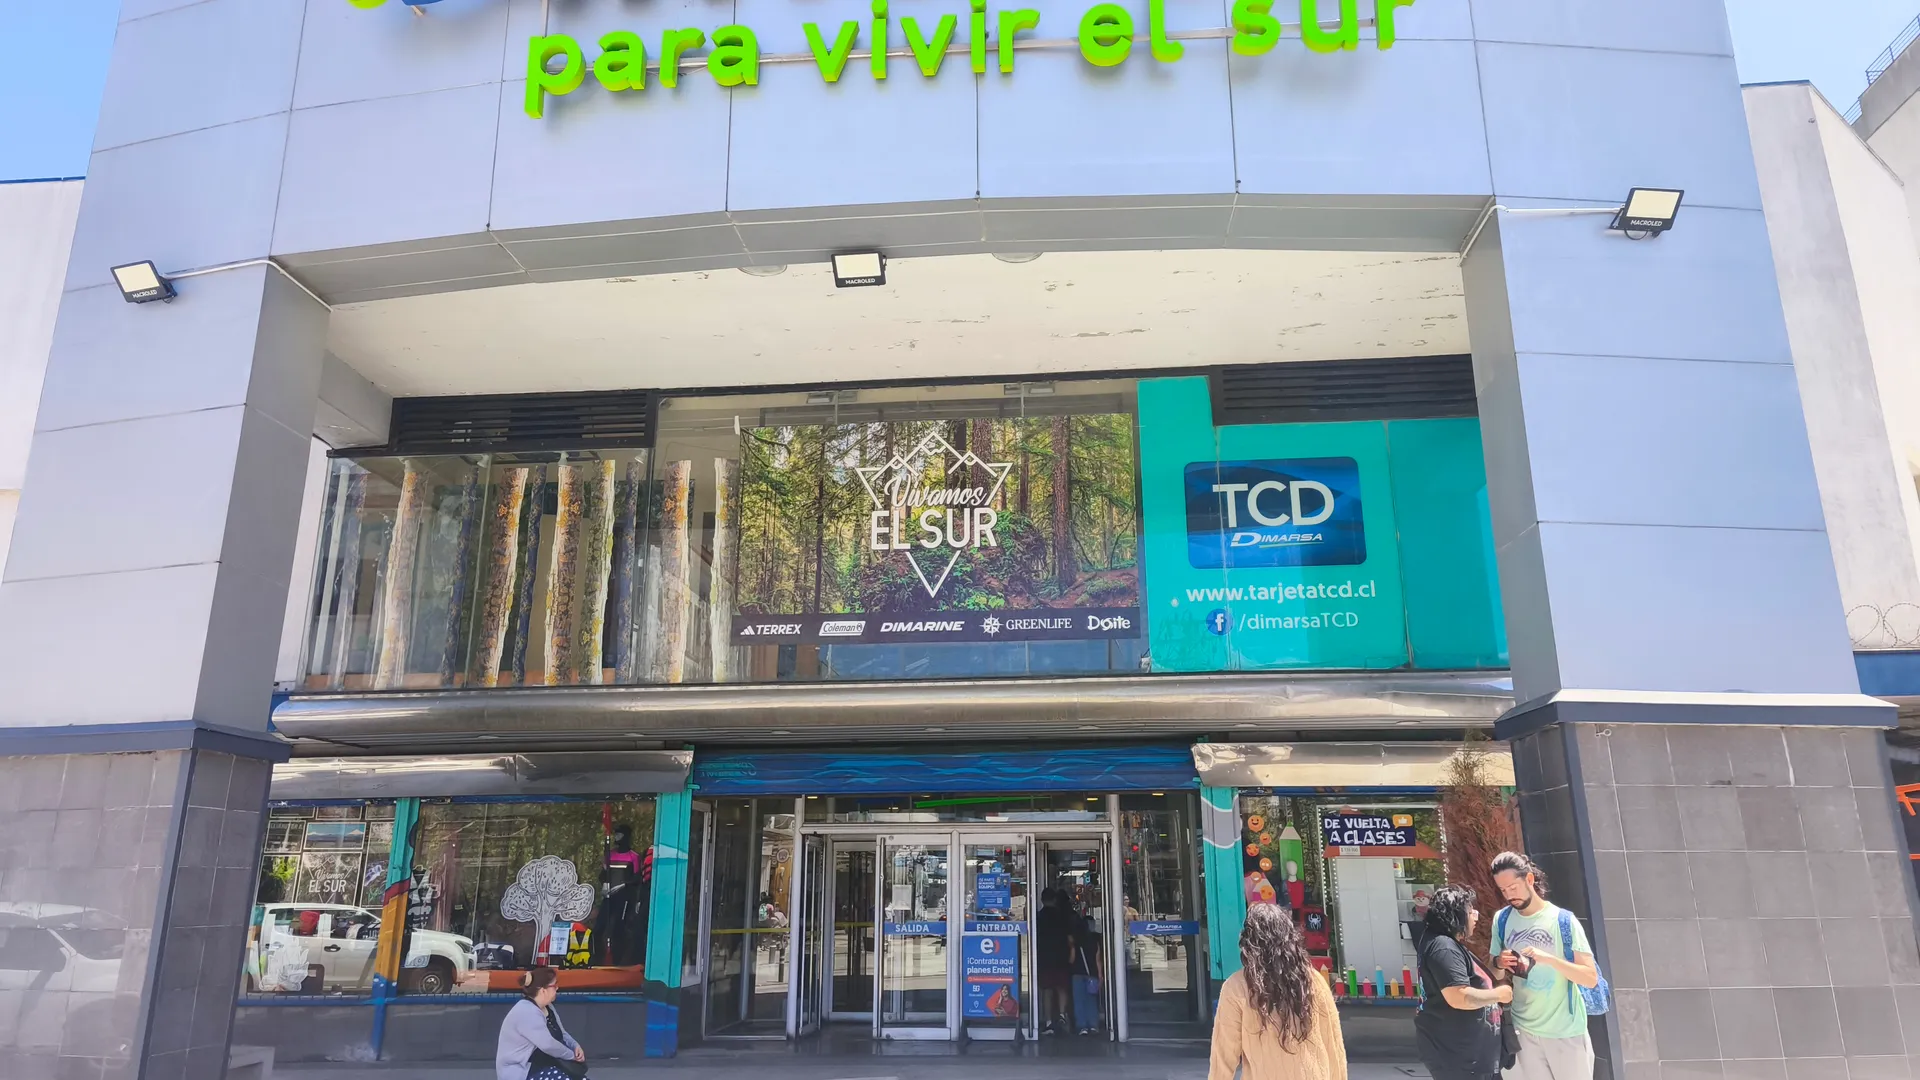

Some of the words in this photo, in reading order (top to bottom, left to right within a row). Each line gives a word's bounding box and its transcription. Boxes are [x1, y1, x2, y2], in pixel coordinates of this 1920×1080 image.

[524, 24, 760, 119] para
[803, 0, 1040, 83] vivir
[1079, 0, 1184, 67] el
[1231, 0, 1415, 56] sur
[1630, 219, 1663, 227] MACROLED
[845, 277, 876, 285] MACROLED
[884, 473, 987, 508] Vivamos
[1212, 480, 1335, 528] TCD
[871, 510, 911, 550] EL
[920, 507, 998, 549] SUR
[1230, 532, 1324, 547] DIMARSA
[1186, 579, 1376, 604] www.tarjetatcd.cl
[823, 622, 856, 633] Coleman
[880, 620, 965, 633] DIMARINE
[1006, 617, 1073, 631] GREENLIFE
[1087, 615, 1131, 631] Doite
[1239, 611, 1359, 632] /dimarsaTCD
[756, 624, 802, 635] TERREX
[1324, 818, 1341, 829] DE
[1344, 817, 1390, 829] VUELTA
[1330, 830, 1341, 843] A
[1343, 830, 1406, 846] CLASES
[314, 868, 345, 880] Vivamos
[308, 879, 321, 893] EL
[323, 879, 347, 893] SUR
[895, 924, 930, 933] SALIDA
[976, 923, 1021, 932] ENTRADA
[967, 966, 991, 975] planes
[992, 966, 1014, 974] Entel!
